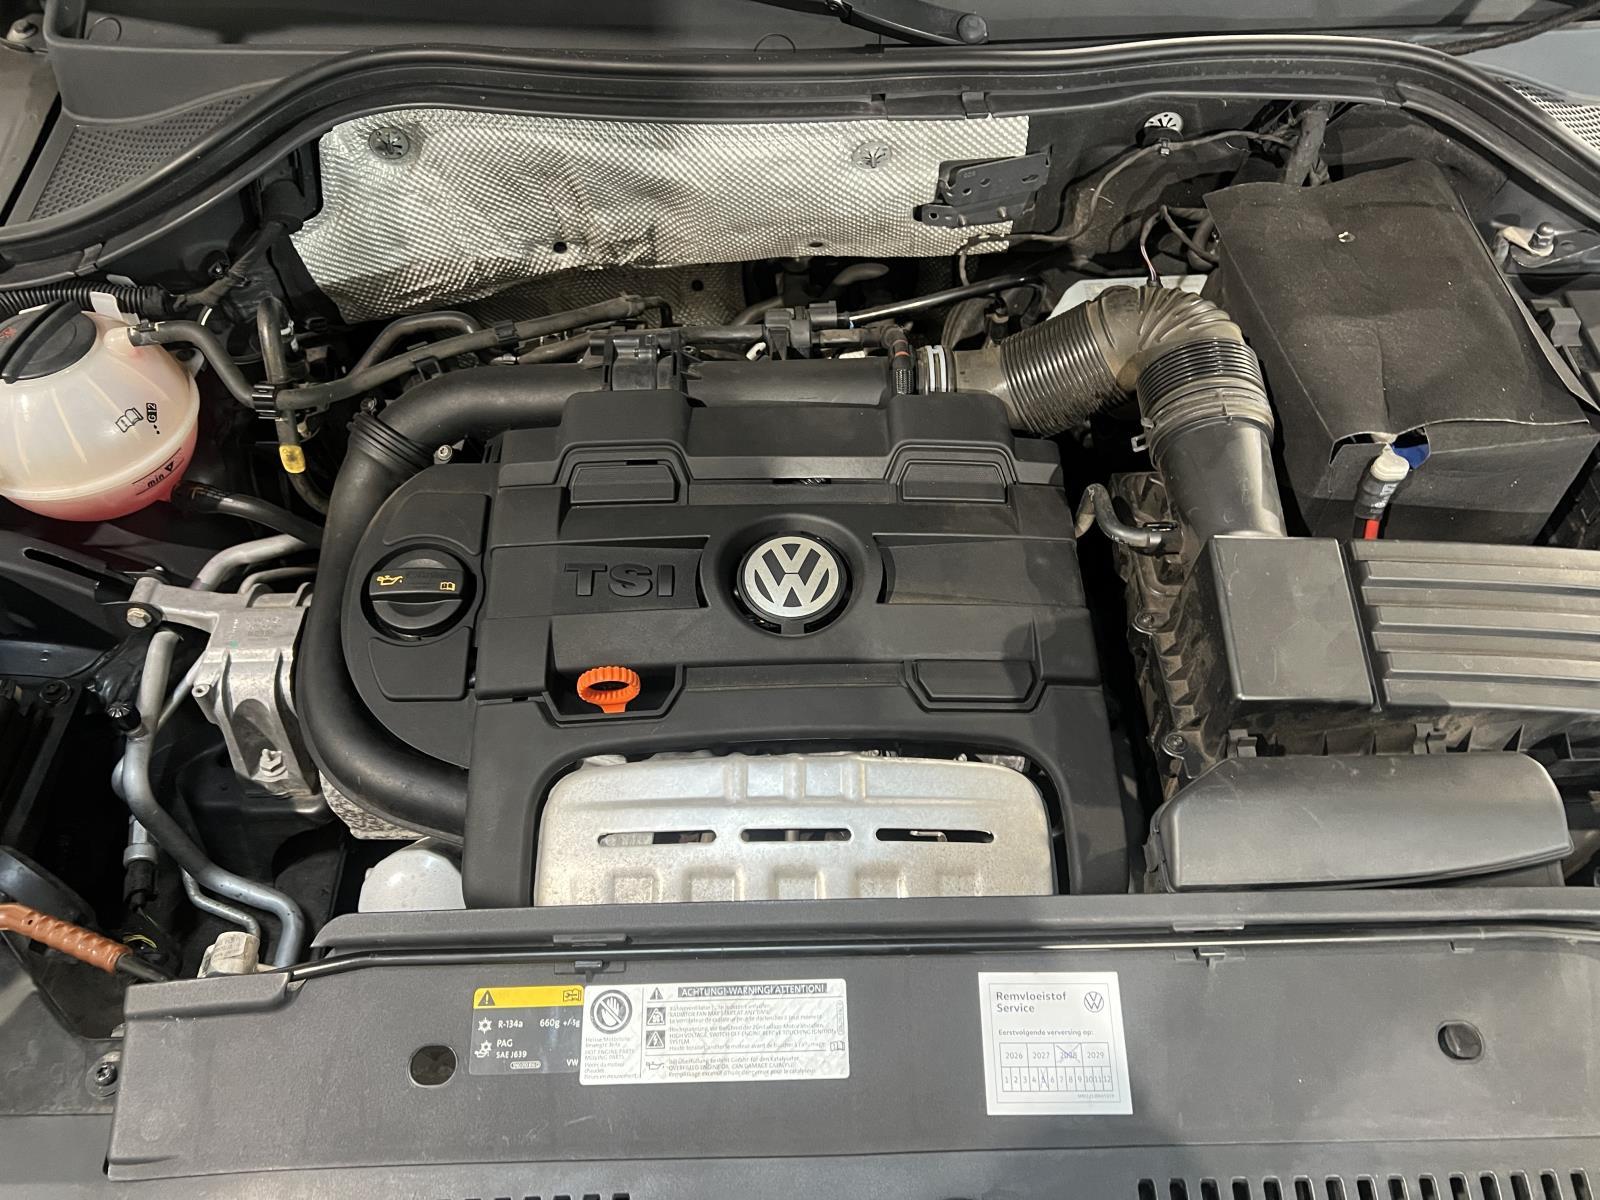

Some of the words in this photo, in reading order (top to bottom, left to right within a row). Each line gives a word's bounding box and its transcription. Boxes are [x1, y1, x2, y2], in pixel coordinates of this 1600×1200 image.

[148, 403, 157, 422] G12
[147, 474, 164, 488] min
[564, 563, 675, 598] TSI
[996, 991, 1066, 1001] Remvloeistof
[996, 1003, 1035, 1012] Service
[498, 1020, 524, 1028] R-134a
[540, 1018, 560, 1028] 660g
[998, 1029, 1046, 1037] Eerstvolgende
[1047, 1028, 1082, 1036] verversing
[496, 1039, 513, 1048] PAG
[510, 1050, 527, 1058] J639
